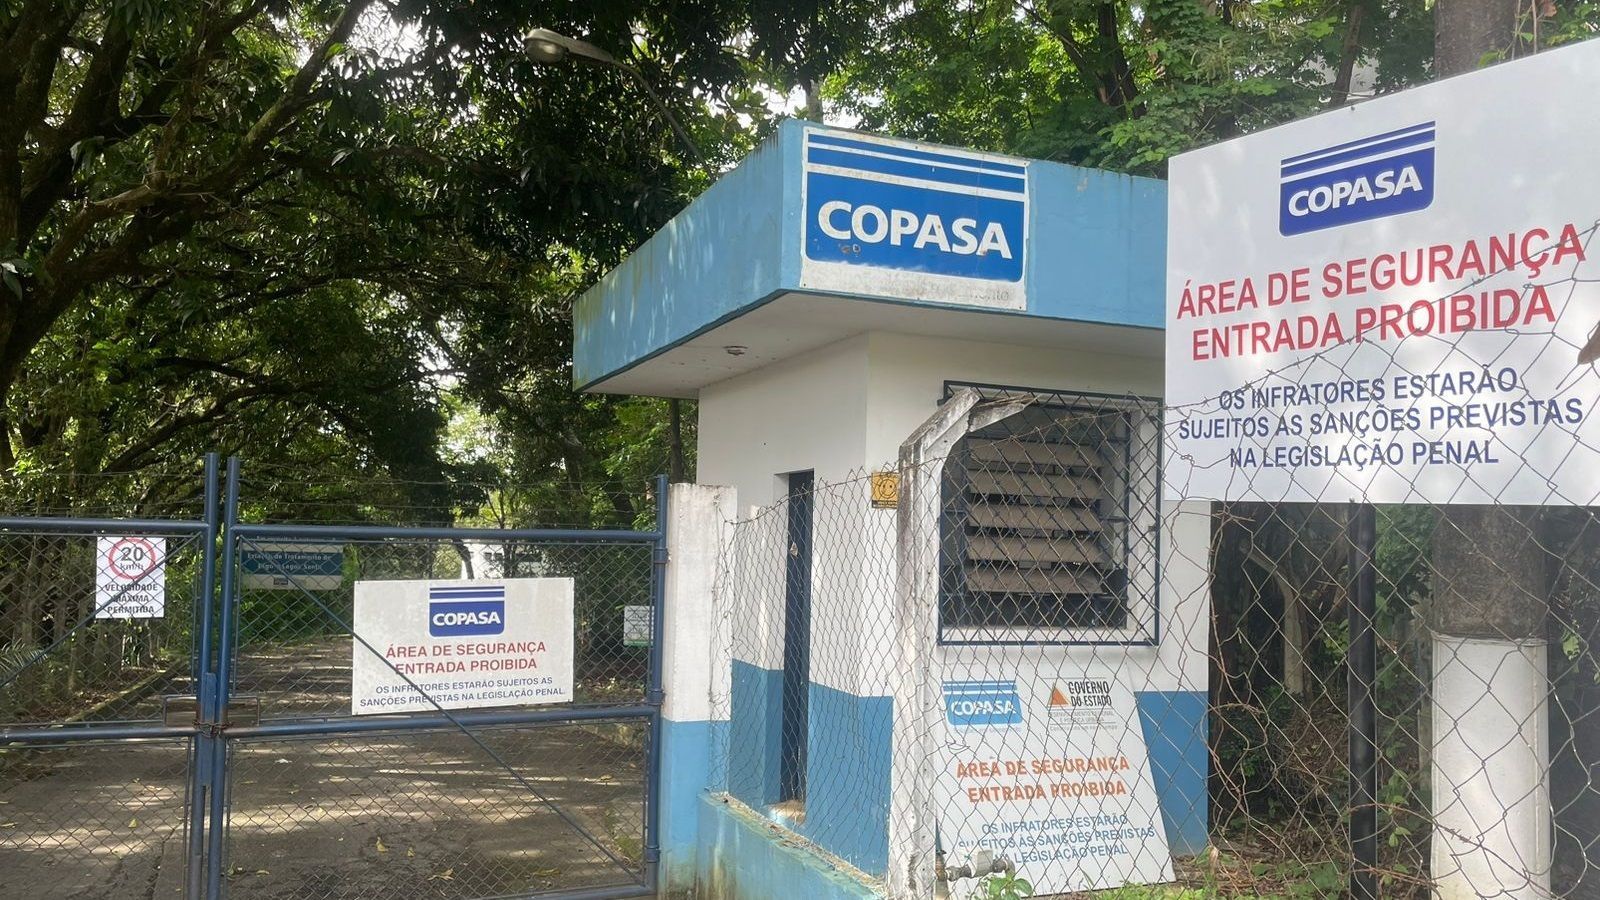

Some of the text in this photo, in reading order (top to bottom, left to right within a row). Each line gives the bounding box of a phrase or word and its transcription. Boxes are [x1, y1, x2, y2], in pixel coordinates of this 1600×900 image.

[1288, 166, 1423, 217] COPASA
[818, 200, 1013, 260] COPASA
[1177, 223, 1586, 320] ÁREA DE SEGURANÇA
[1192, 284, 1556, 361] ENTRADA PROIBIDA
[1219, 389, 1245, 411] OS
[1251, 378, 1386, 409] INFRATORES
[1179, 416, 1270, 440] SUJEITOS
[1309, 404, 1421, 439] SANÇÕES
[1430, 398, 1584, 430] PREVISTAS
[1230, 438, 1499, 472] NA LEGISLAÇÃO PENAL
[121, 547, 144, 562] 20
[114, 593, 149, 602] ÁXIMA
[432, 611, 501, 627] COPASA
[386, 641, 546, 658] ÁREA DE SEGURANÇA
[395, 658, 537, 675] ENTRADA PROIBIDA
[375, 685, 390, 694] OS
[452, 680, 495, 690] ESTARÃO
[496, 677, 539, 687] SUJEITOS
[477, 688, 533, 700] LEGISLAÇÃO
[1068, 681, 1110, 694] GOVERNO
[951, 700, 1017, 716] COPASA
[1070, 694, 1112, 707] DO ESTADO
[1005, 760, 1028, 776] DE
[967, 780, 1127, 803] ENTRADA PROIBIDA
[981, 813, 1127, 834] OS INFRATORES ESTARÃO
[1094, 826, 1155, 841] PREVISTAS
[1090, 843, 1128, 857] PENAL
